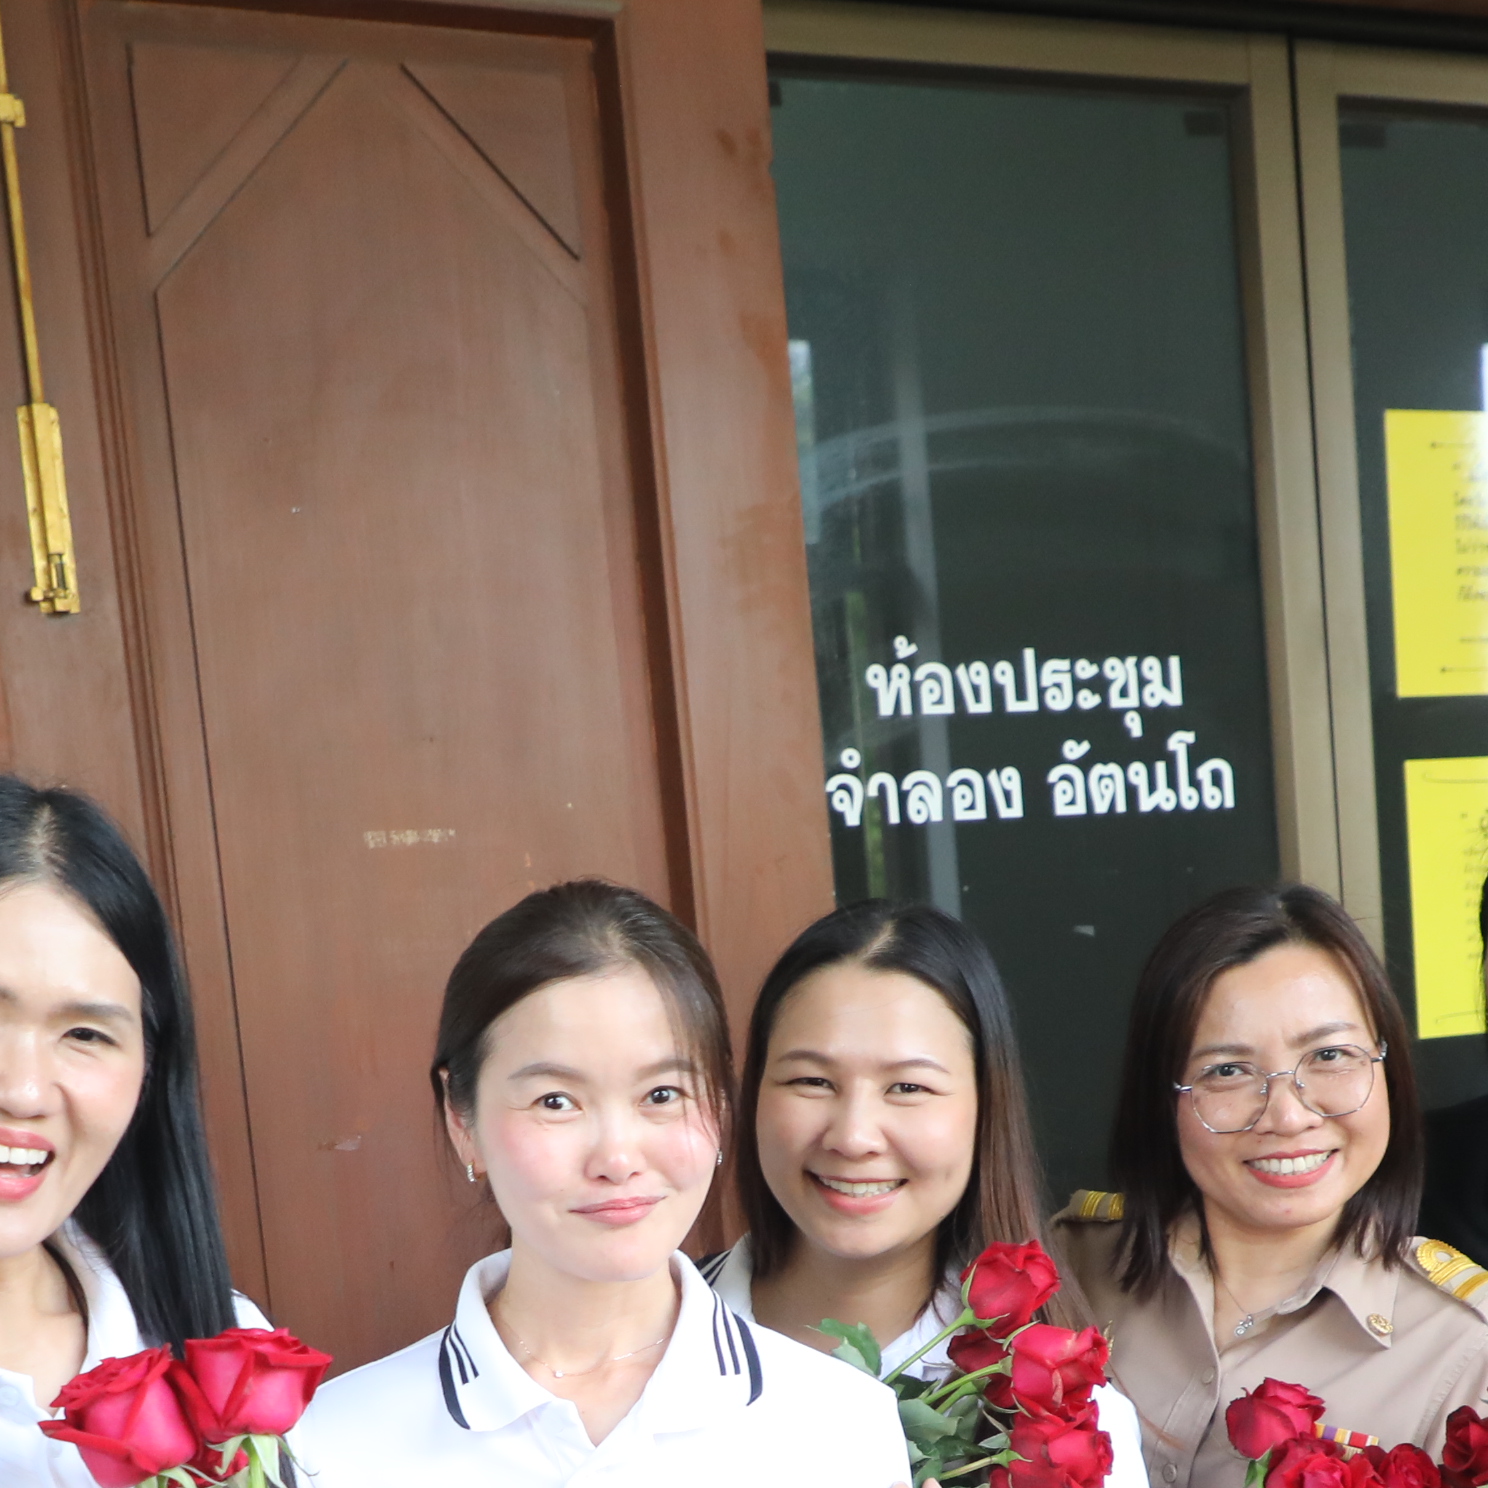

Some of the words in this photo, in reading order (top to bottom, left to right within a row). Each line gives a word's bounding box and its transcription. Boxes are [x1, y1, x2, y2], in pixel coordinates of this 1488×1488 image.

[866, 635, 1183, 738] ห้องประชุม
[825, 747, 1023, 827] จำลอง
[1046, 731, 1237, 818] อัตนโถ
